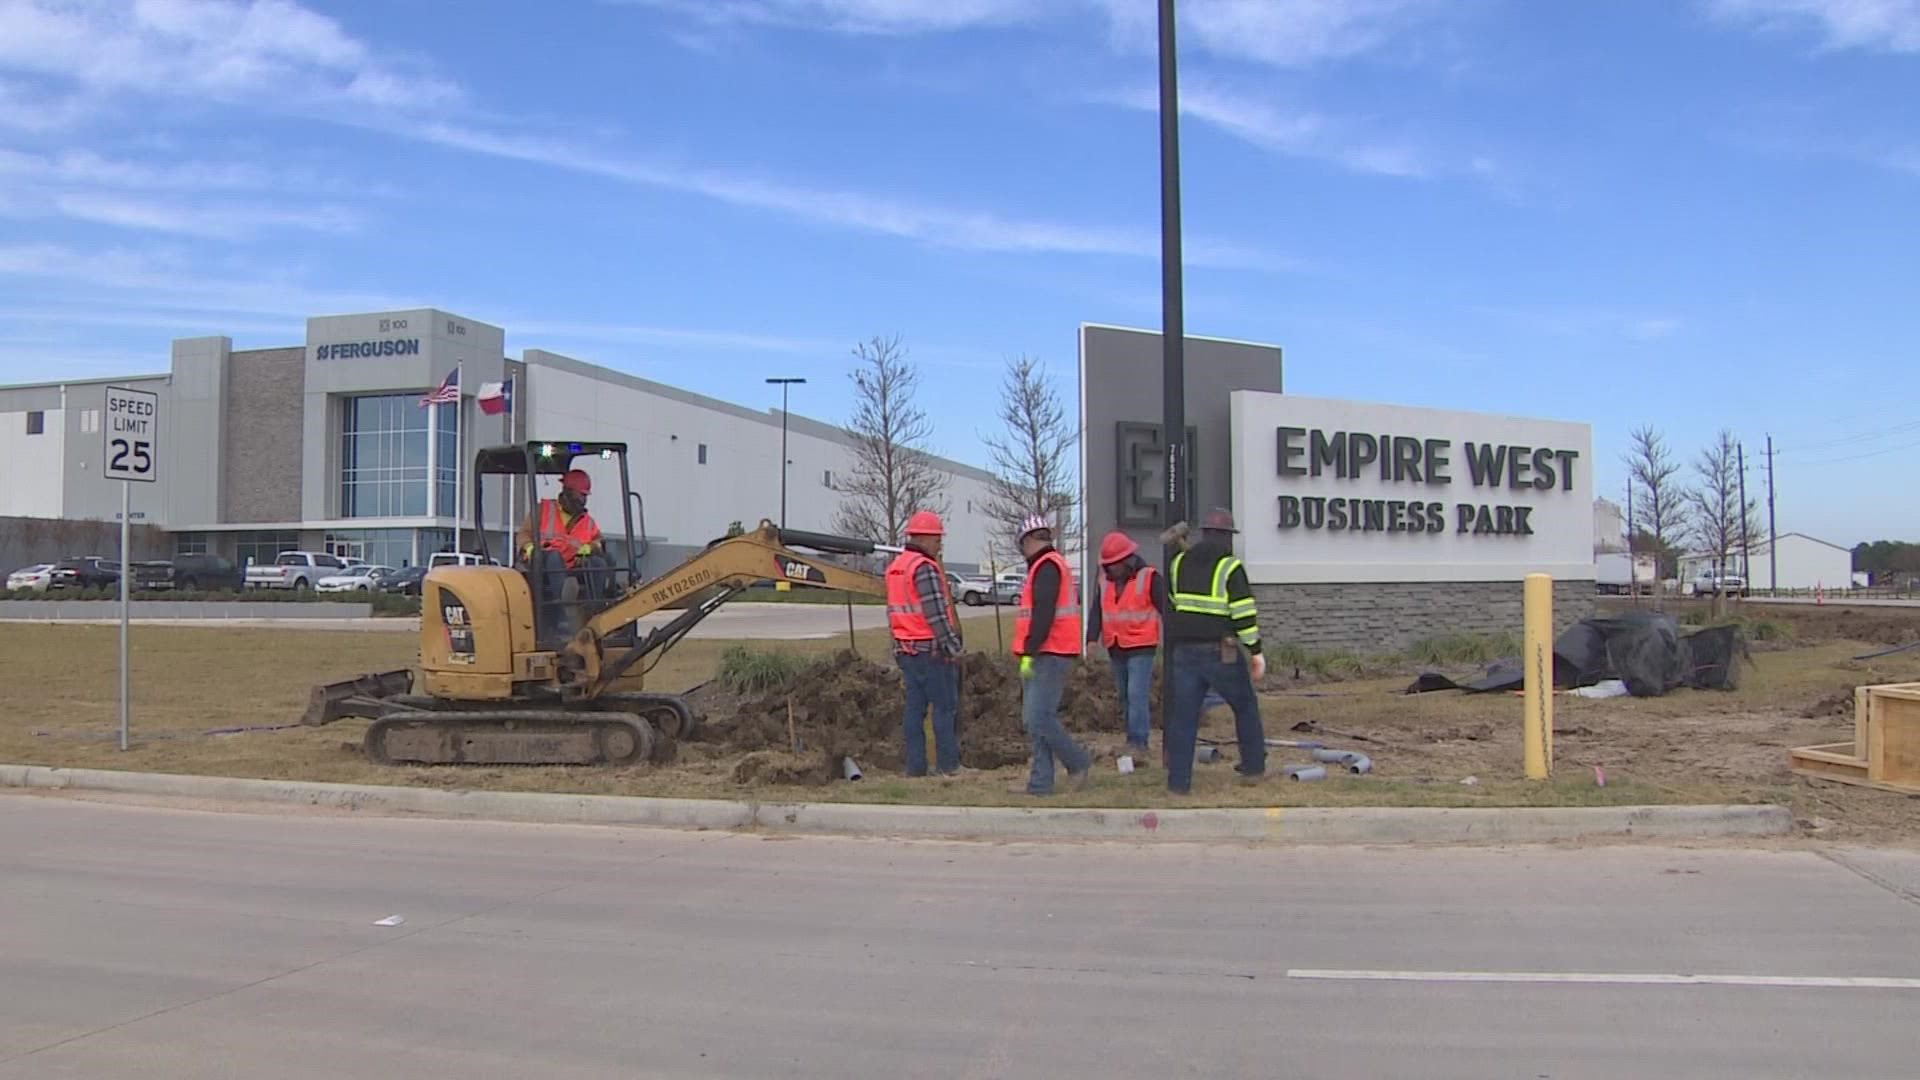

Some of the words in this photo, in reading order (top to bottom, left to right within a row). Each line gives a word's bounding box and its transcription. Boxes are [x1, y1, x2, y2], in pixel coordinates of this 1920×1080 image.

[392, 319, 408, 329] 100
[331, 339, 419, 360] FERGUSON
[109, 398, 153, 416] SPEED
[114, 417, 148, 434] LIMIT
[110, 438, 151, 473] 25
[1276, 426, 1452, 484] EMPIRE
[1464, 442, 1579, 491] WEST
[1277, 496, 1445, 533] BUSINESS
[1456, 503, 1534, 536] PARK
[785, 562, 811, 580] CAT
[445, 606, 465, 625] CAT
